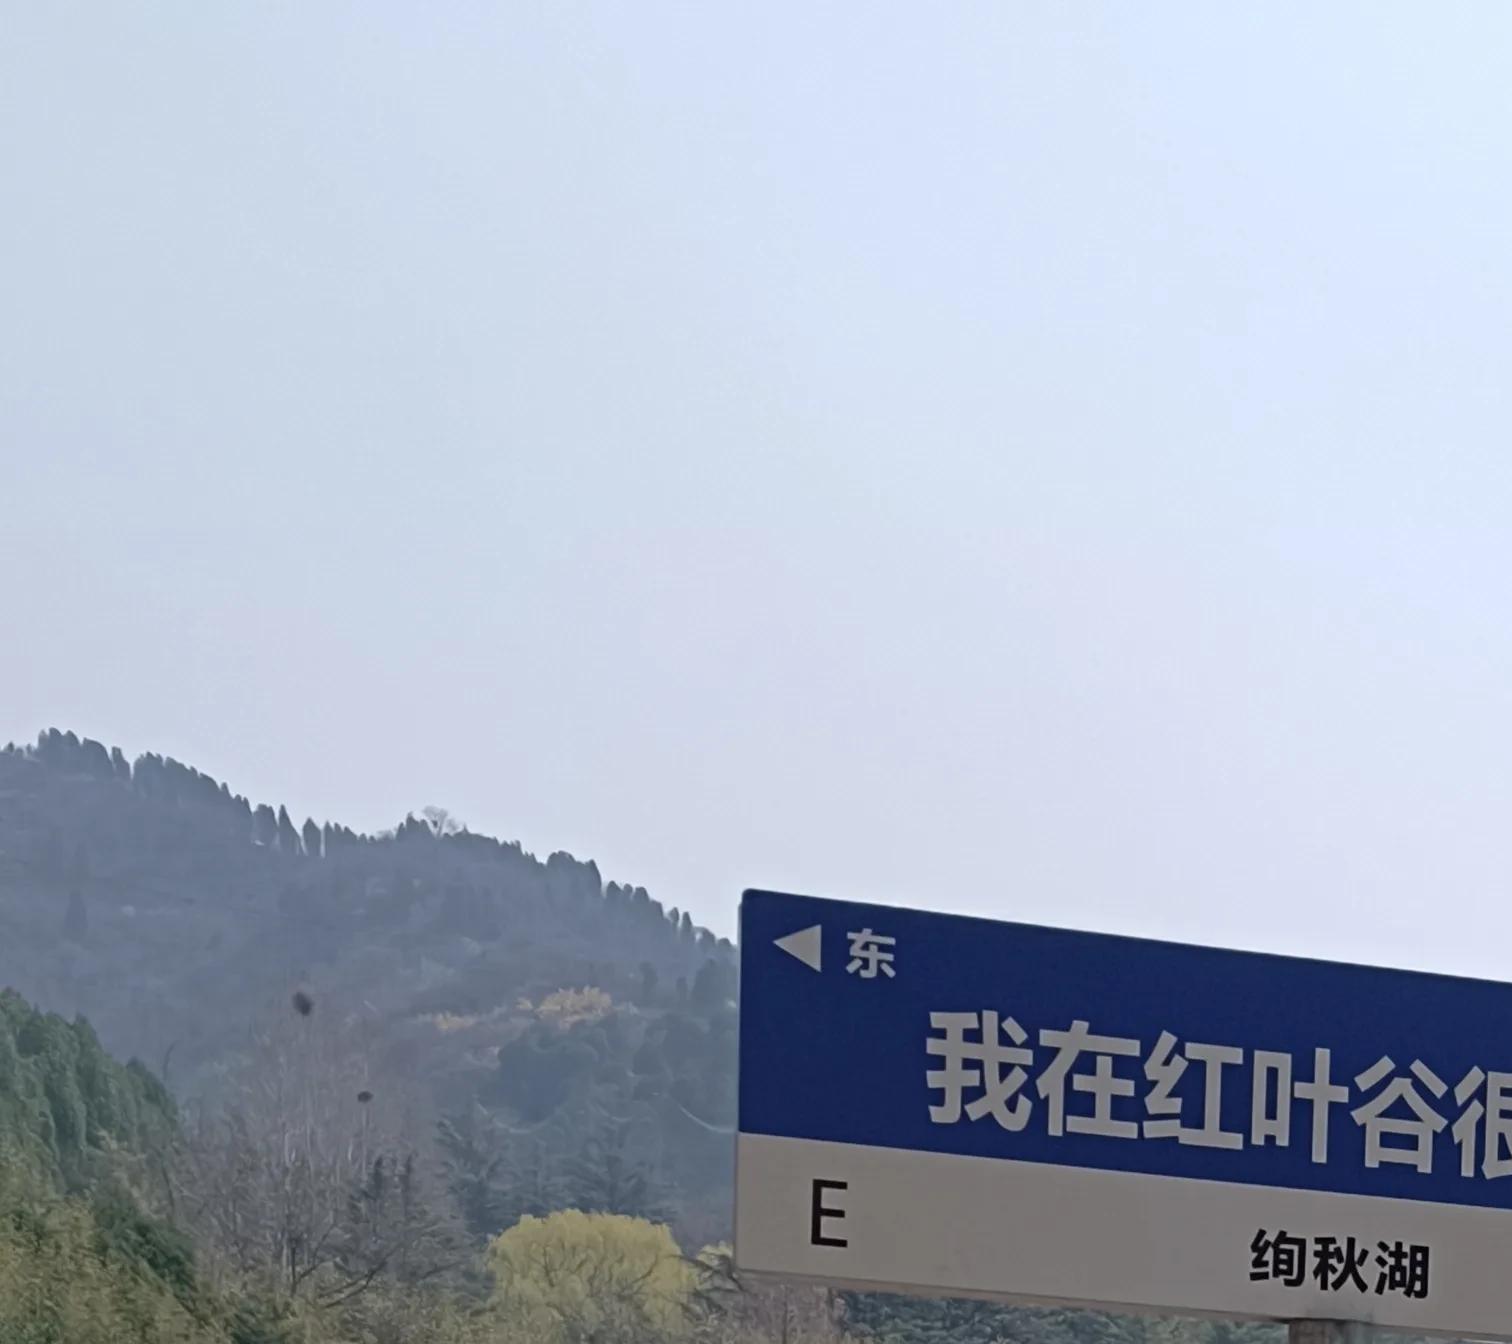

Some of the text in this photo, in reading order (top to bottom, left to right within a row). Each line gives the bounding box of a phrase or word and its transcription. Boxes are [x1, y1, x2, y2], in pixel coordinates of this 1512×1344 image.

[845, 927, 897, 979] 东
[810, 1178, 849, 1248] E
[1249, 1228, 1430, 1299] 绚秋湖
